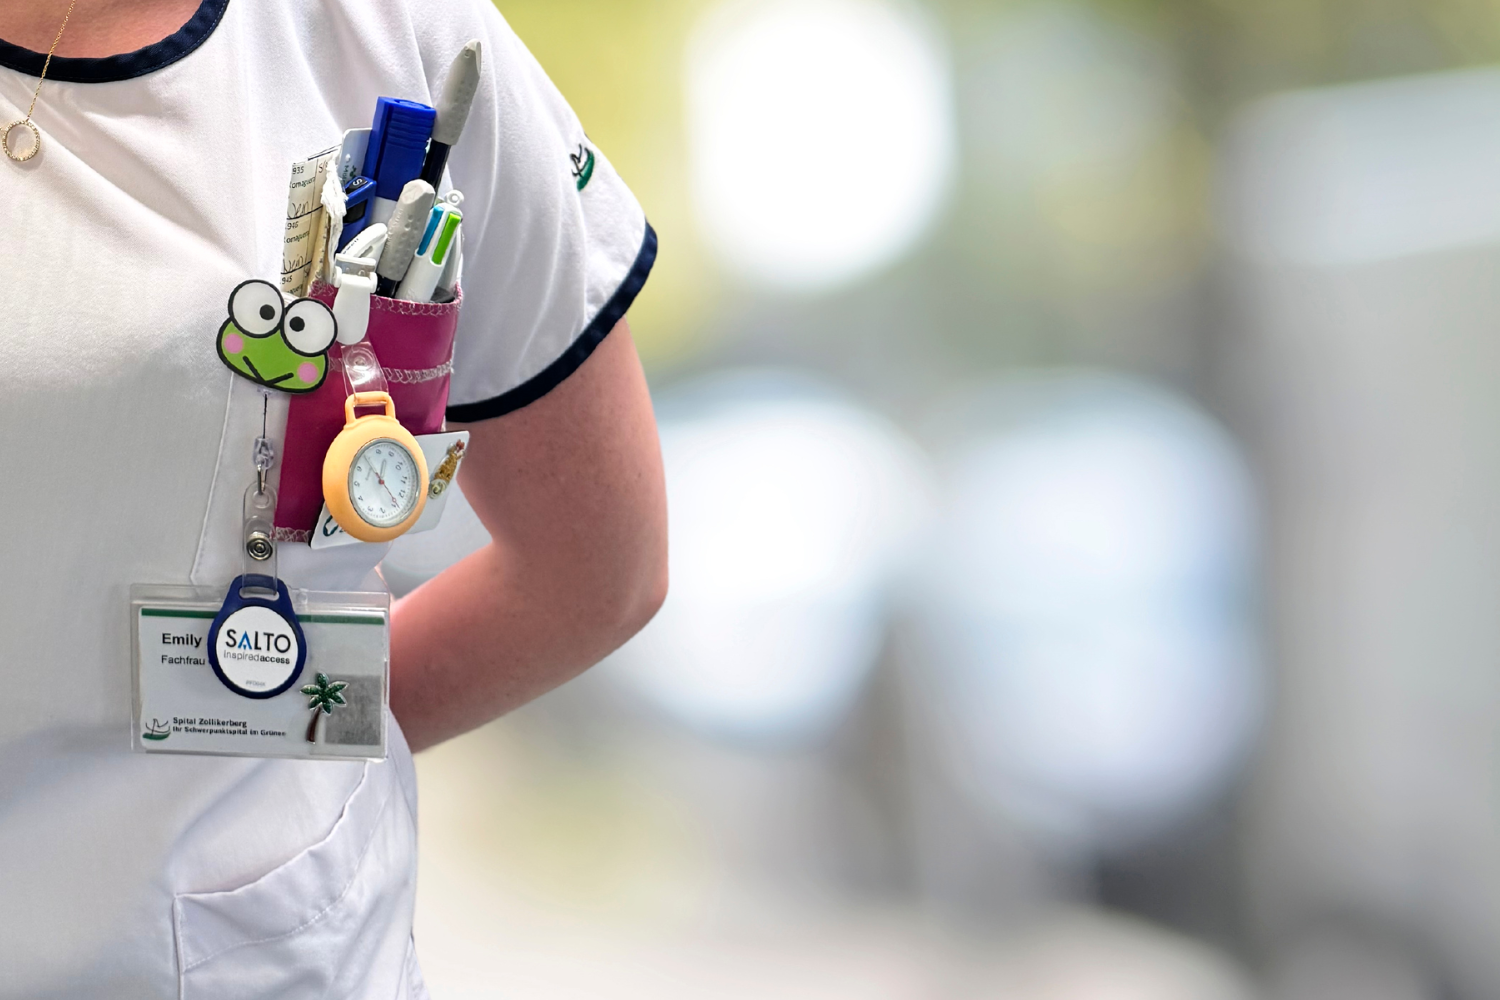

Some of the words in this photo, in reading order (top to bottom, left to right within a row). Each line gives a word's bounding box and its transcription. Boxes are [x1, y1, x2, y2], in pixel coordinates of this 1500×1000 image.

[162, 632, 203, 648] Emily
[225, 628, 291, 653] SALTO
[161, 654, 206, 666] Fachfrau
[173, 716, 196, 725] Spital
[198, 717, 248, 728] Zollikerberg
[184, 726, 248, 736] Schwerpunktspital
[260, 729, 287, 737] Grünen
